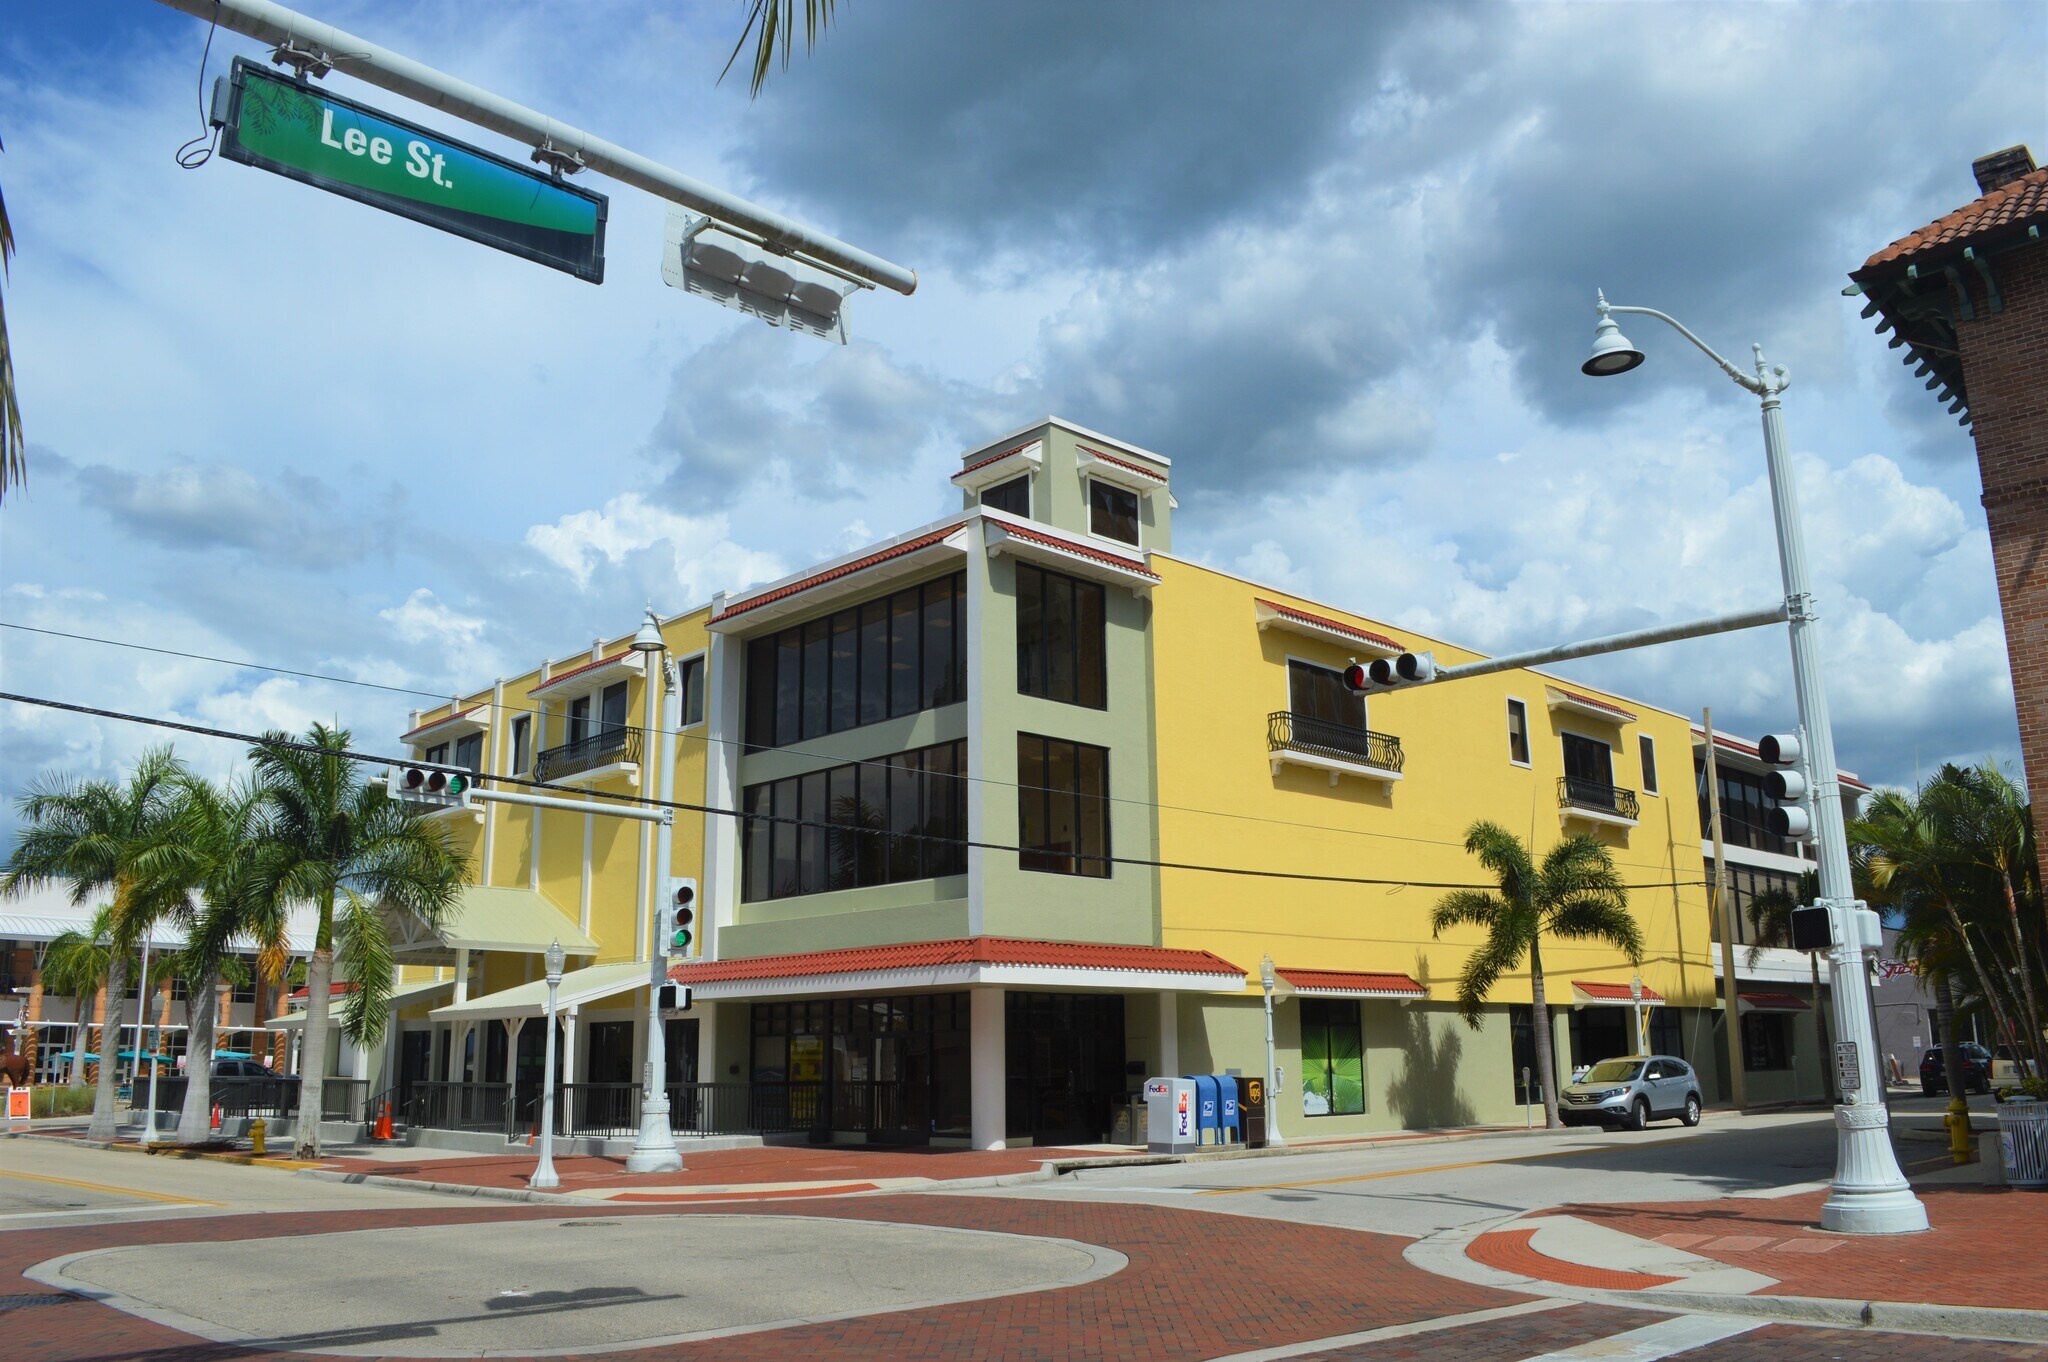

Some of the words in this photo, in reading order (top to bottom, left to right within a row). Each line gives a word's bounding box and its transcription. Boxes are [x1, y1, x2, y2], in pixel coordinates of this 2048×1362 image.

[320, 108, 393, 165] Lee
[405, 140, 453, 188] St.
[1148, 1084, 1168, 1093] FedEx
[1178, 1091, 1188, 1136] FedEx
